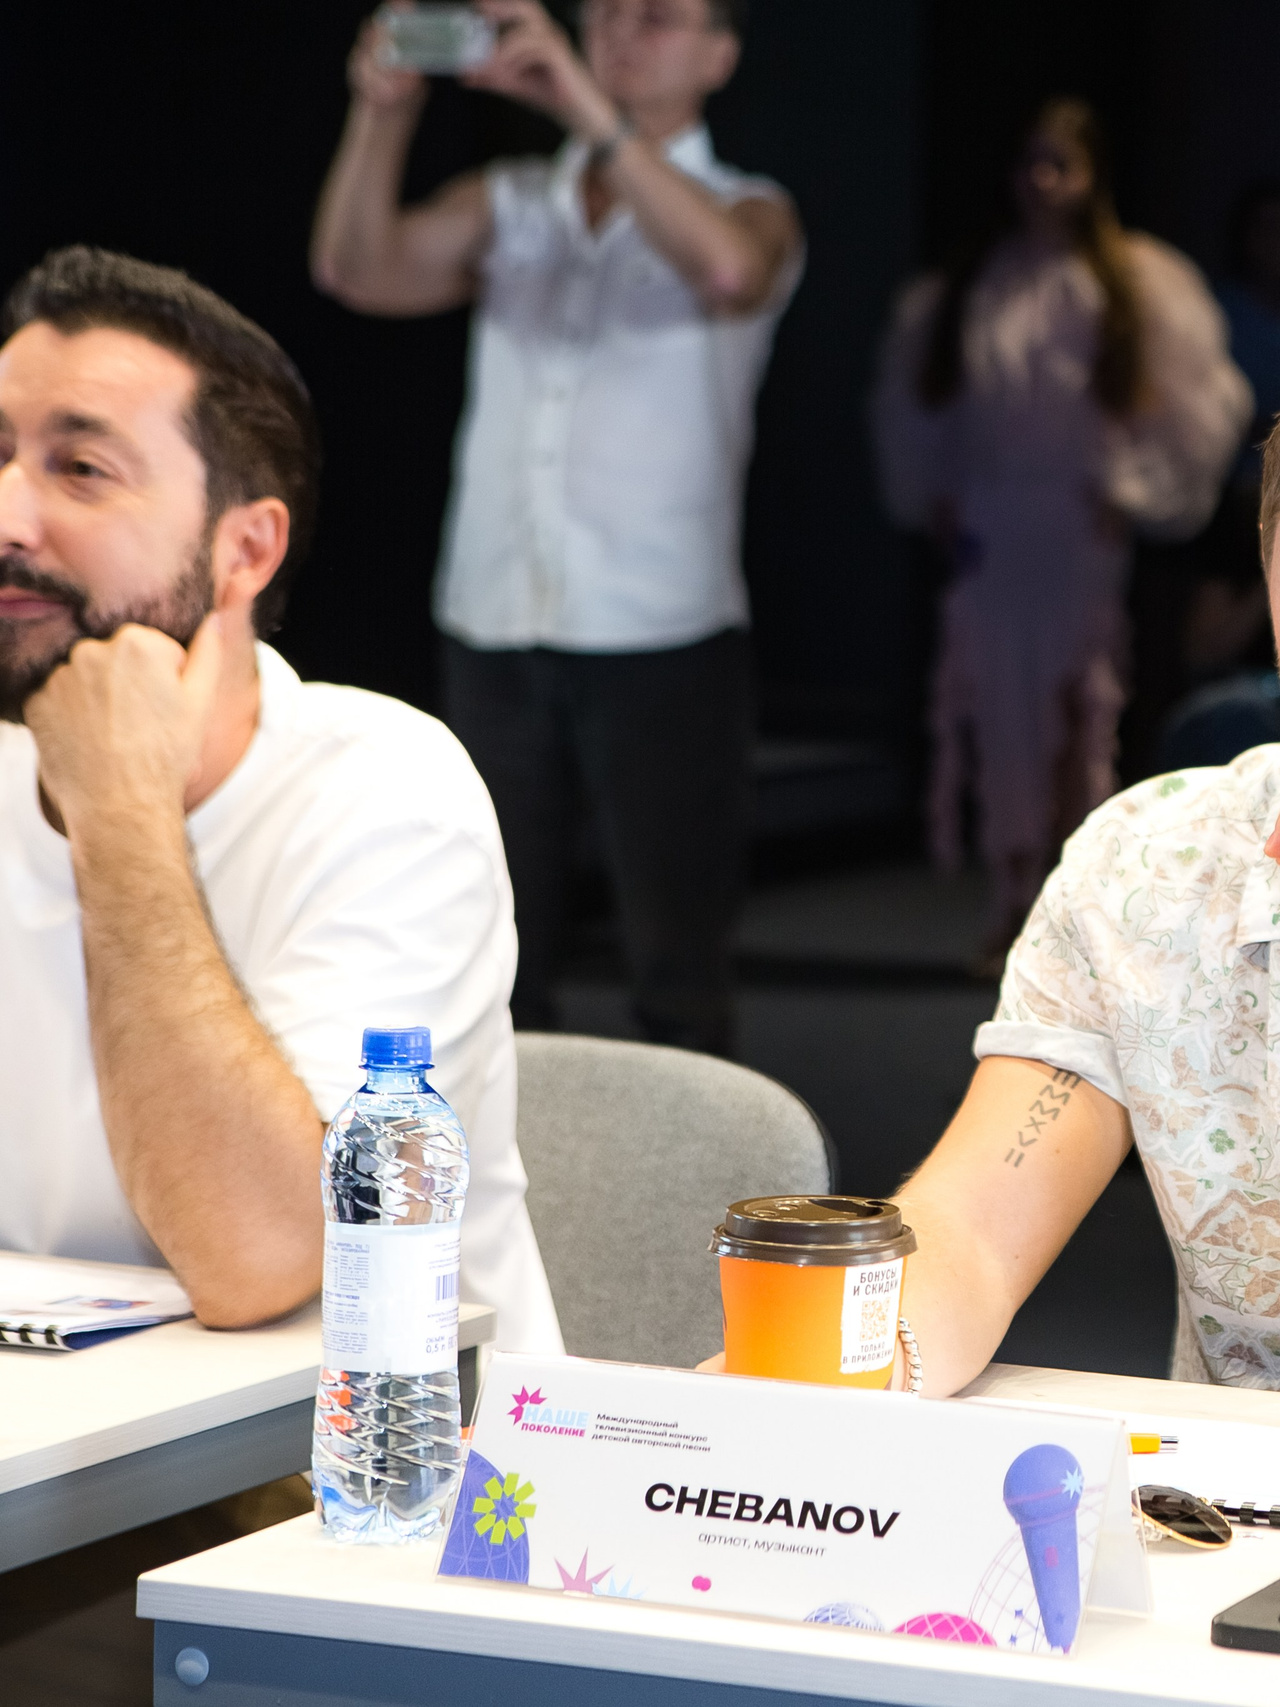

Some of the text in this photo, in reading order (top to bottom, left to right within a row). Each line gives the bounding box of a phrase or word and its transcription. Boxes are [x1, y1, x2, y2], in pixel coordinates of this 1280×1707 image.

[860, 1267, 897, 1284] БОНУСЫ
[853, 1279, 898, 1296] И СКИДКИ
[861, 1341, 885, 1353] ТОЛЬКО
[843, 1355, 848, 1364] В
[523, 1406, 590, 1427] НАШЕ
[596, 1413, 679, 1429] Международный
[521, 1423, 586, 1438] ПОКОЛЕНИЕ
[594, 1423, 708, 1443] телевизионный конкурс
[591, 1433, 711, 1453] детской авторской песни
[644, 1482, 901, 1539] CHEBANOV
[698, 1530, 827, 1558] артист, музыкант
